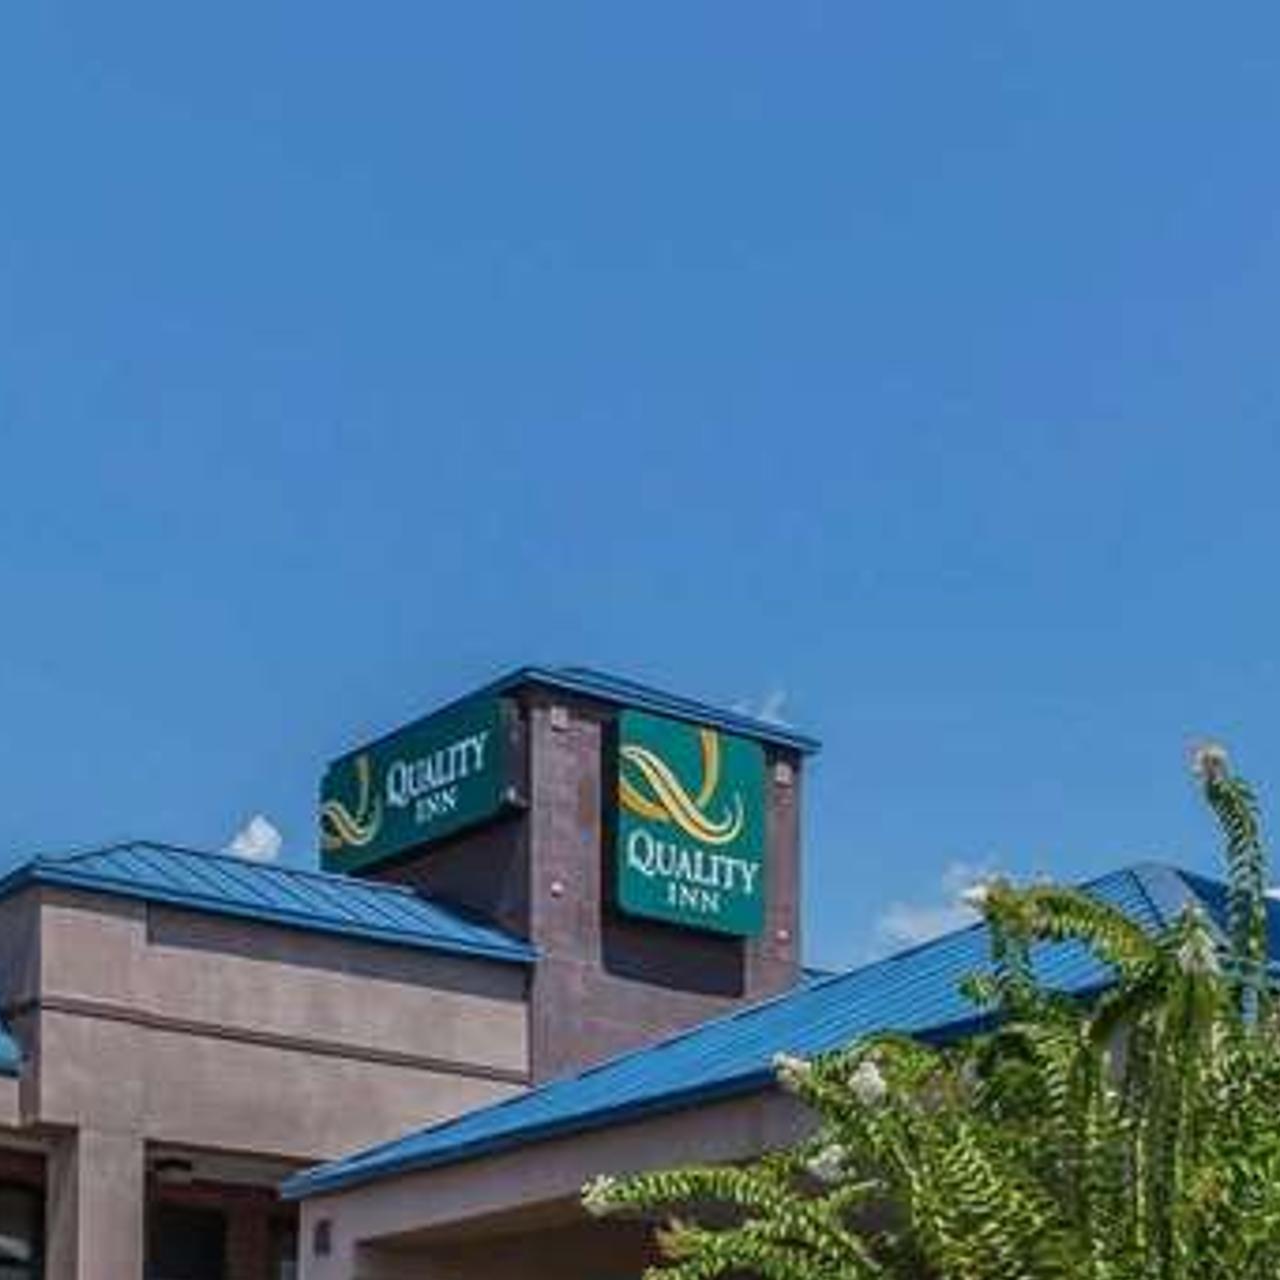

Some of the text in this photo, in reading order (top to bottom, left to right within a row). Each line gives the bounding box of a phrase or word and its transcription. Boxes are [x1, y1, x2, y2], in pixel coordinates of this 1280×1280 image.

[386, 732, 489, 807] QUALITY
[416, 784, 458, 823] INN
[628, 829, 761, 895] QUALITY
[668, 881, 721, 913] INN
